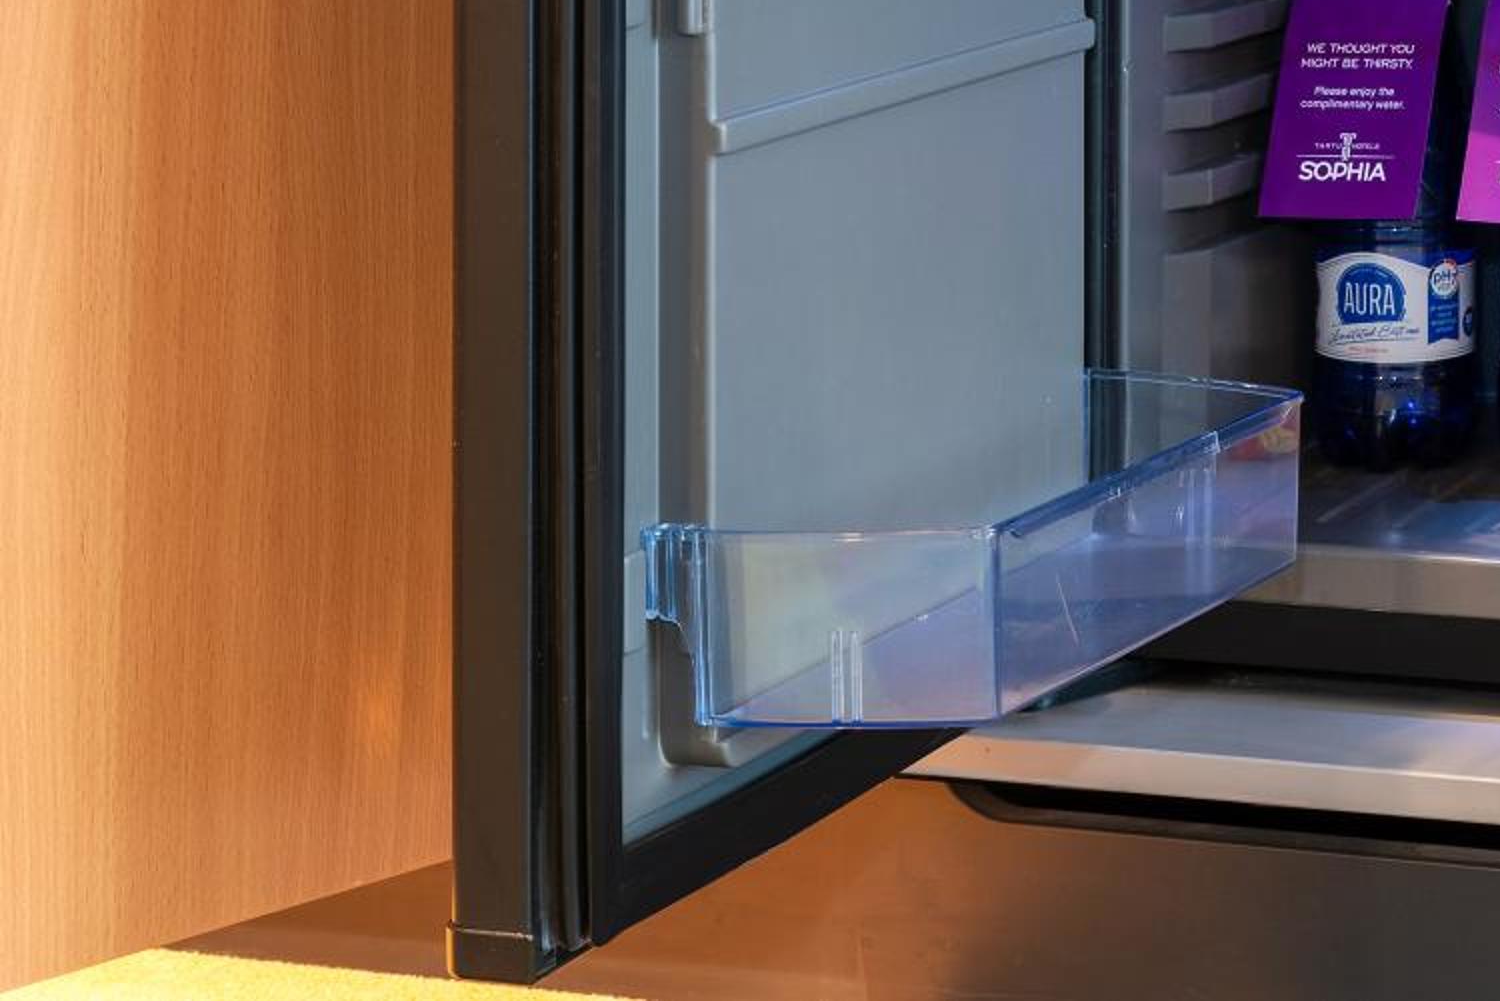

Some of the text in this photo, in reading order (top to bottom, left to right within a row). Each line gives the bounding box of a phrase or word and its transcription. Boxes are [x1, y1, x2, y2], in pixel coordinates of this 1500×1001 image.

[1307, 42, 1415, 54] WE THOUGHT YOU
[1301, 58, 1339, 68] MIGHT
[1341, 58, 1360, 69] BE
[1314, 86, 1395, 98] Please enjoy the
[1300, 99, 1406, 111] complimentary water.
[1298, 160, 1386, 182] SOPHIA
[1343, 282, 1396, 316] AURA
